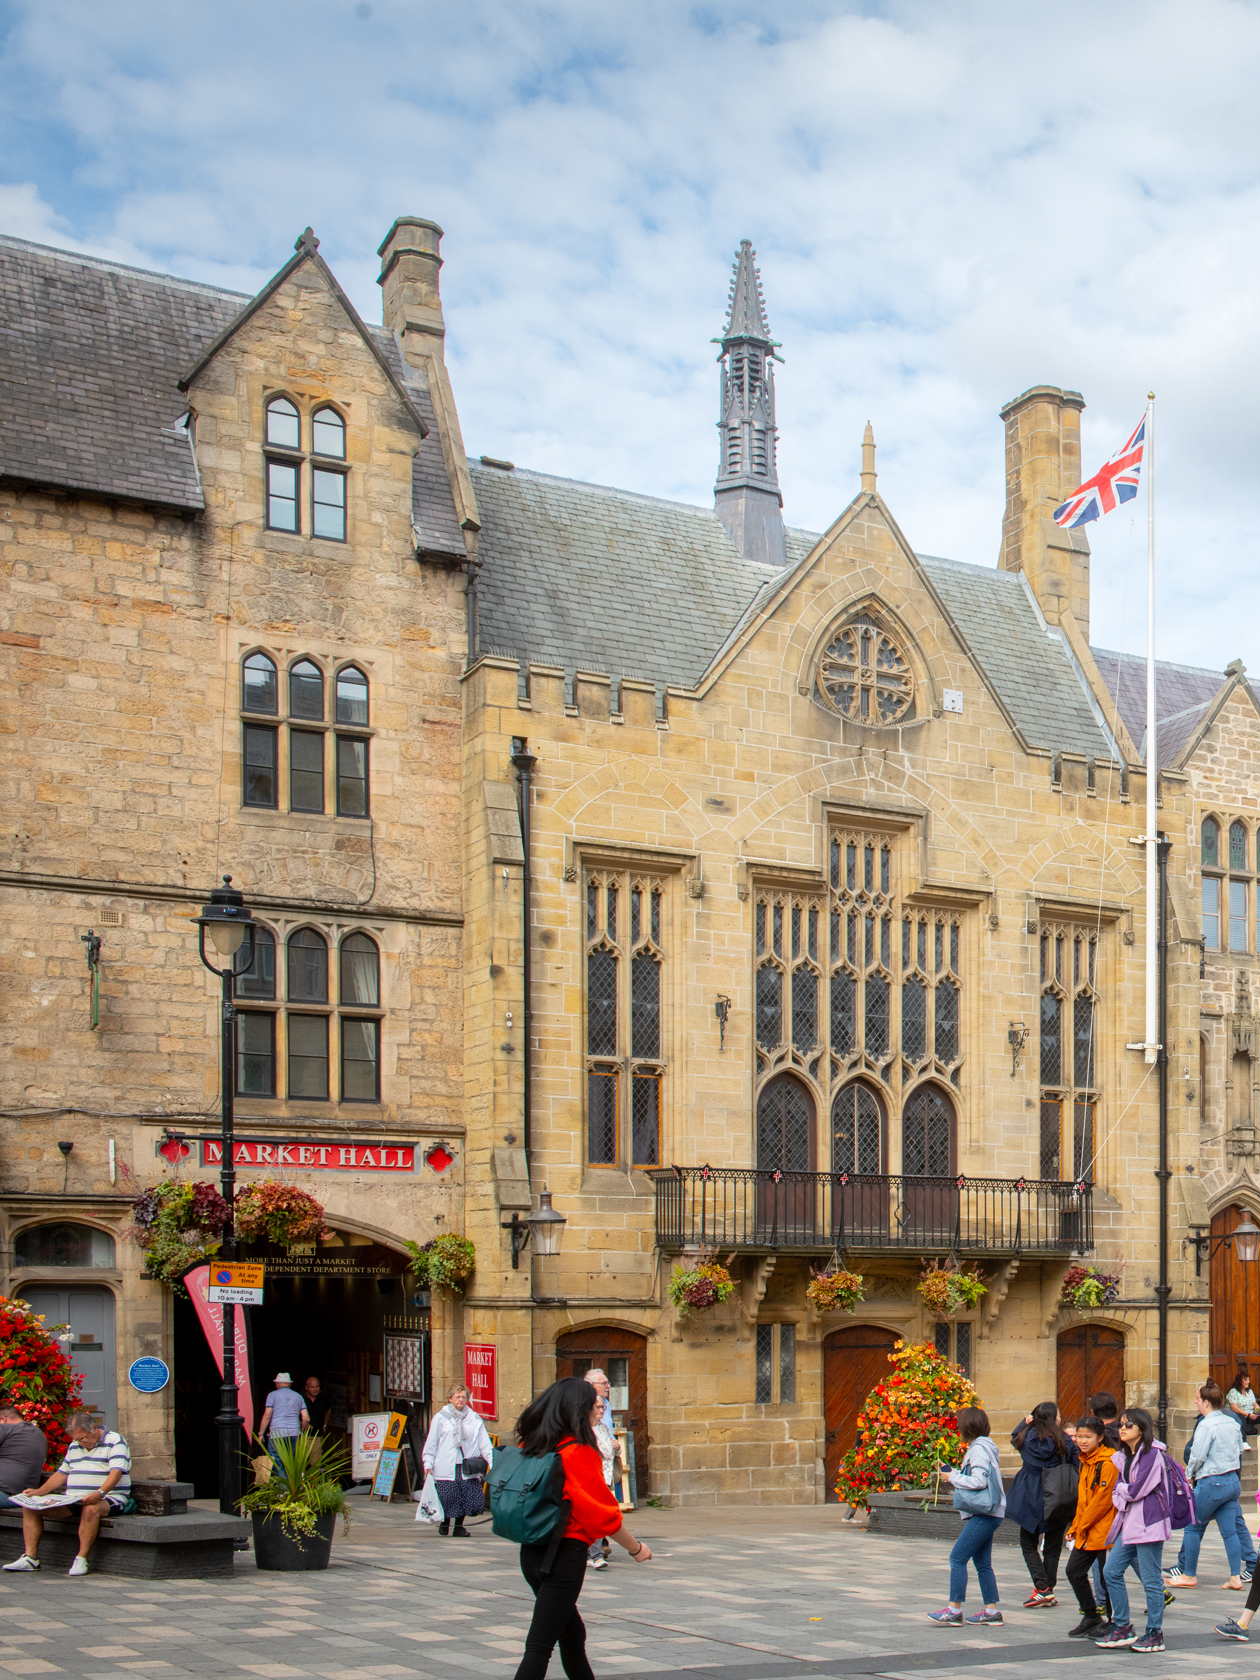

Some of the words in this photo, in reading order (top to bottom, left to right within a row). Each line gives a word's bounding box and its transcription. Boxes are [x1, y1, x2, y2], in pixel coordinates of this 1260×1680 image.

[207, 1143, 332, 1165] MARKET
[338, 1147, 412, 1168] HALL
[313, 1266, 366, 1274] DEPARTMENT
[467, 1351, 492, 1366] MARKET
[472, 1373, 488, 1388] HALL
